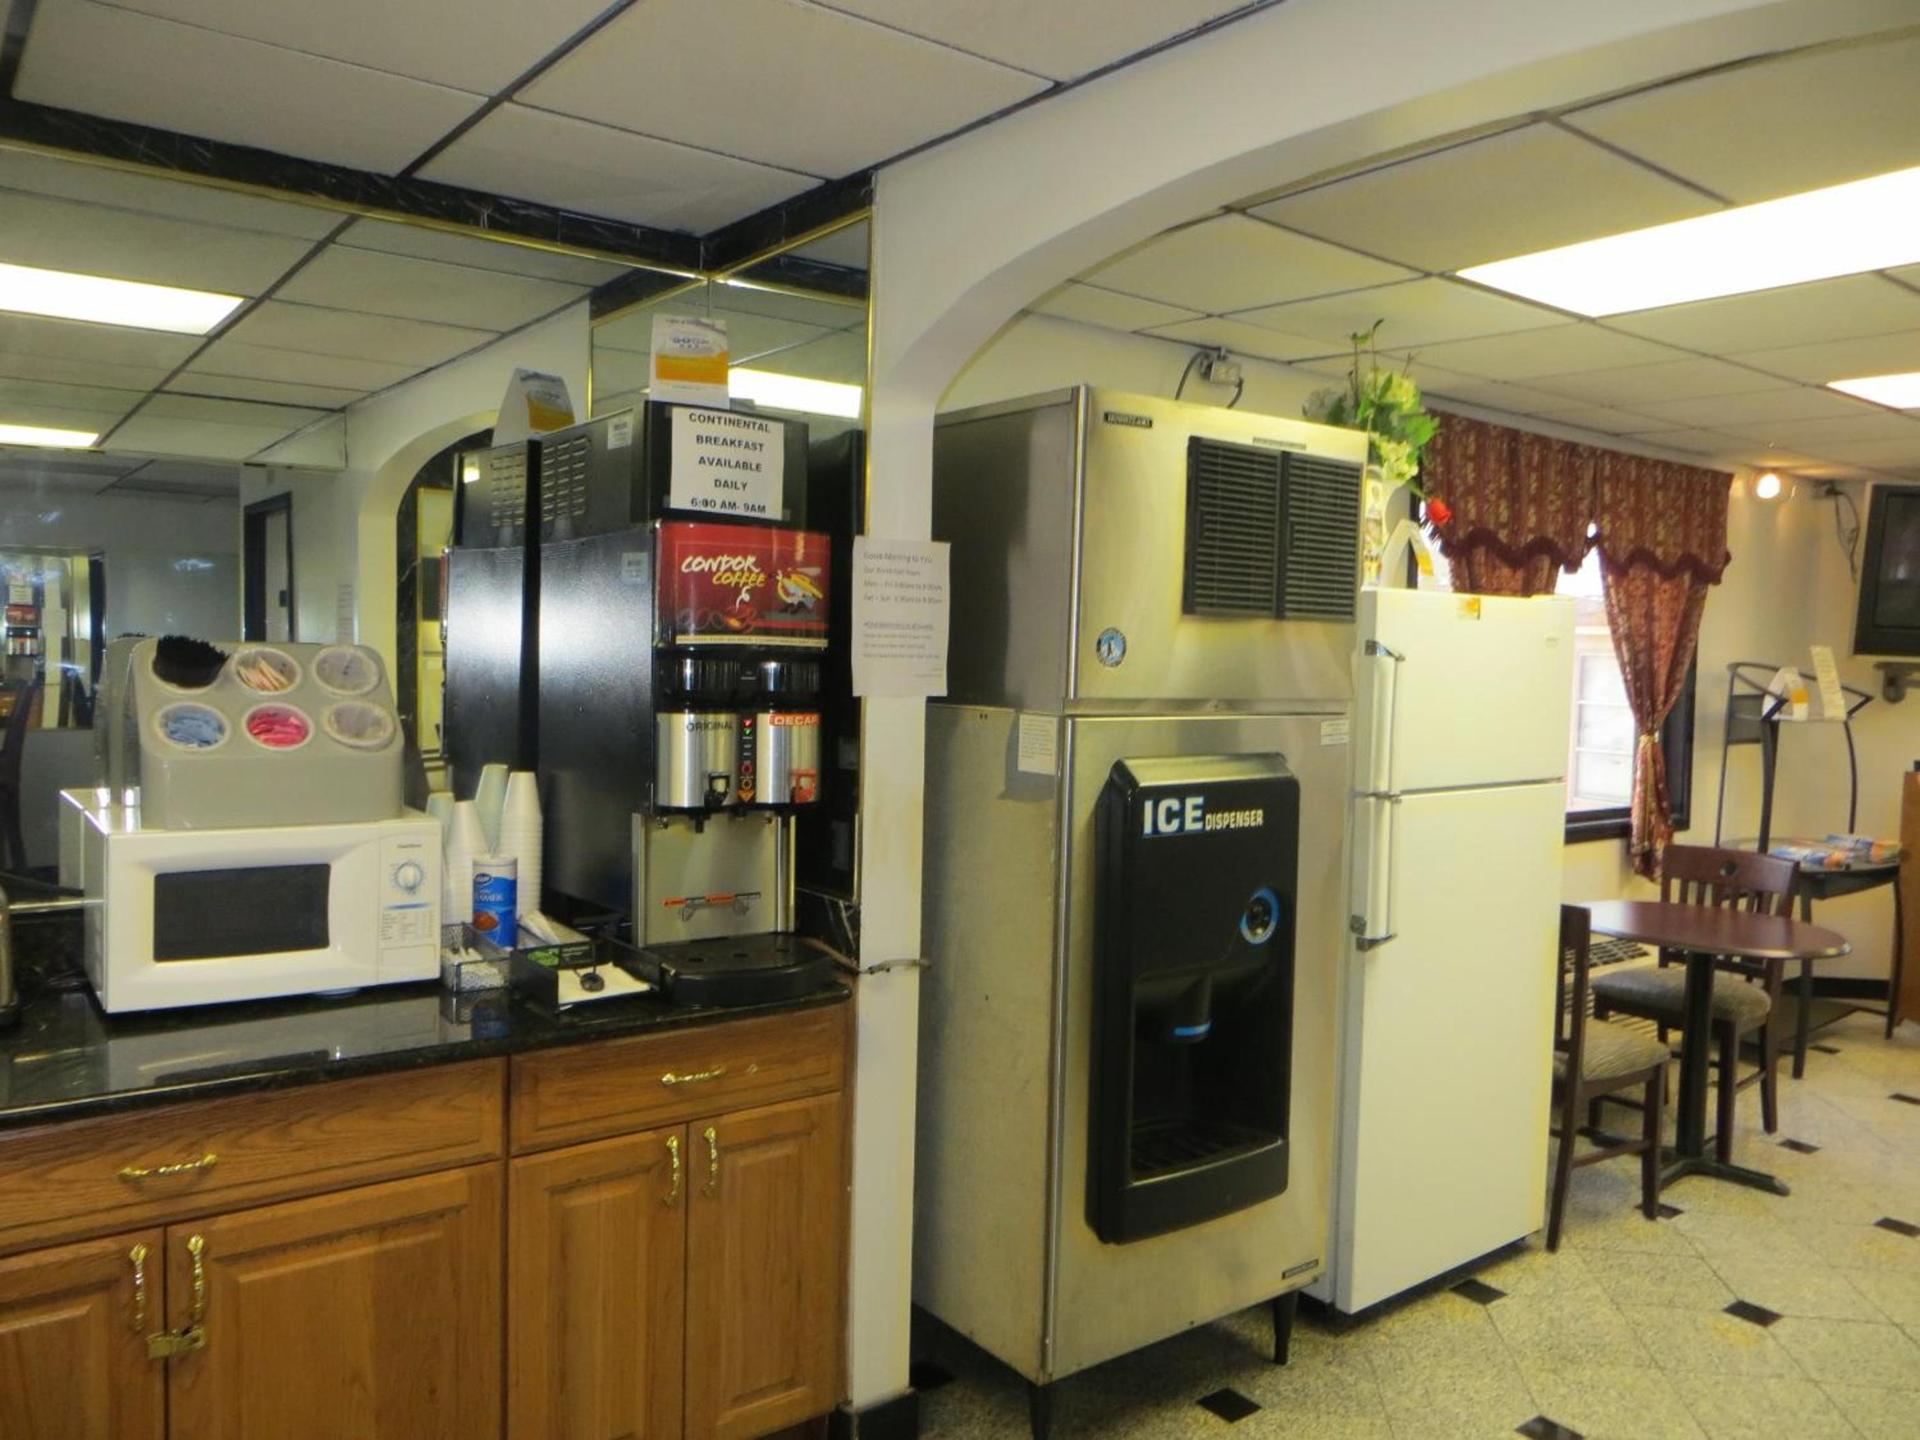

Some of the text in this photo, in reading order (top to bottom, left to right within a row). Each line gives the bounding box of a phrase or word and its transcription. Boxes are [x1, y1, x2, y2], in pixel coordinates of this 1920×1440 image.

[689, 412, 771, 433] CONTINENTAL
[696, 434, 765, 452] BREAKFAST
[698, 455, 763, 473] AVAILABLE
[714, 478, 749, 492] DAILY
[743, 502, 767, 514] 9AM
[681, 554, 761, 574] CONDOR
[712, 571, 767, 588] COFFEE
[686, 720, 733, 733] ORIGINAL
[1143, 796, 1264, 836] ICE DISPENSER
